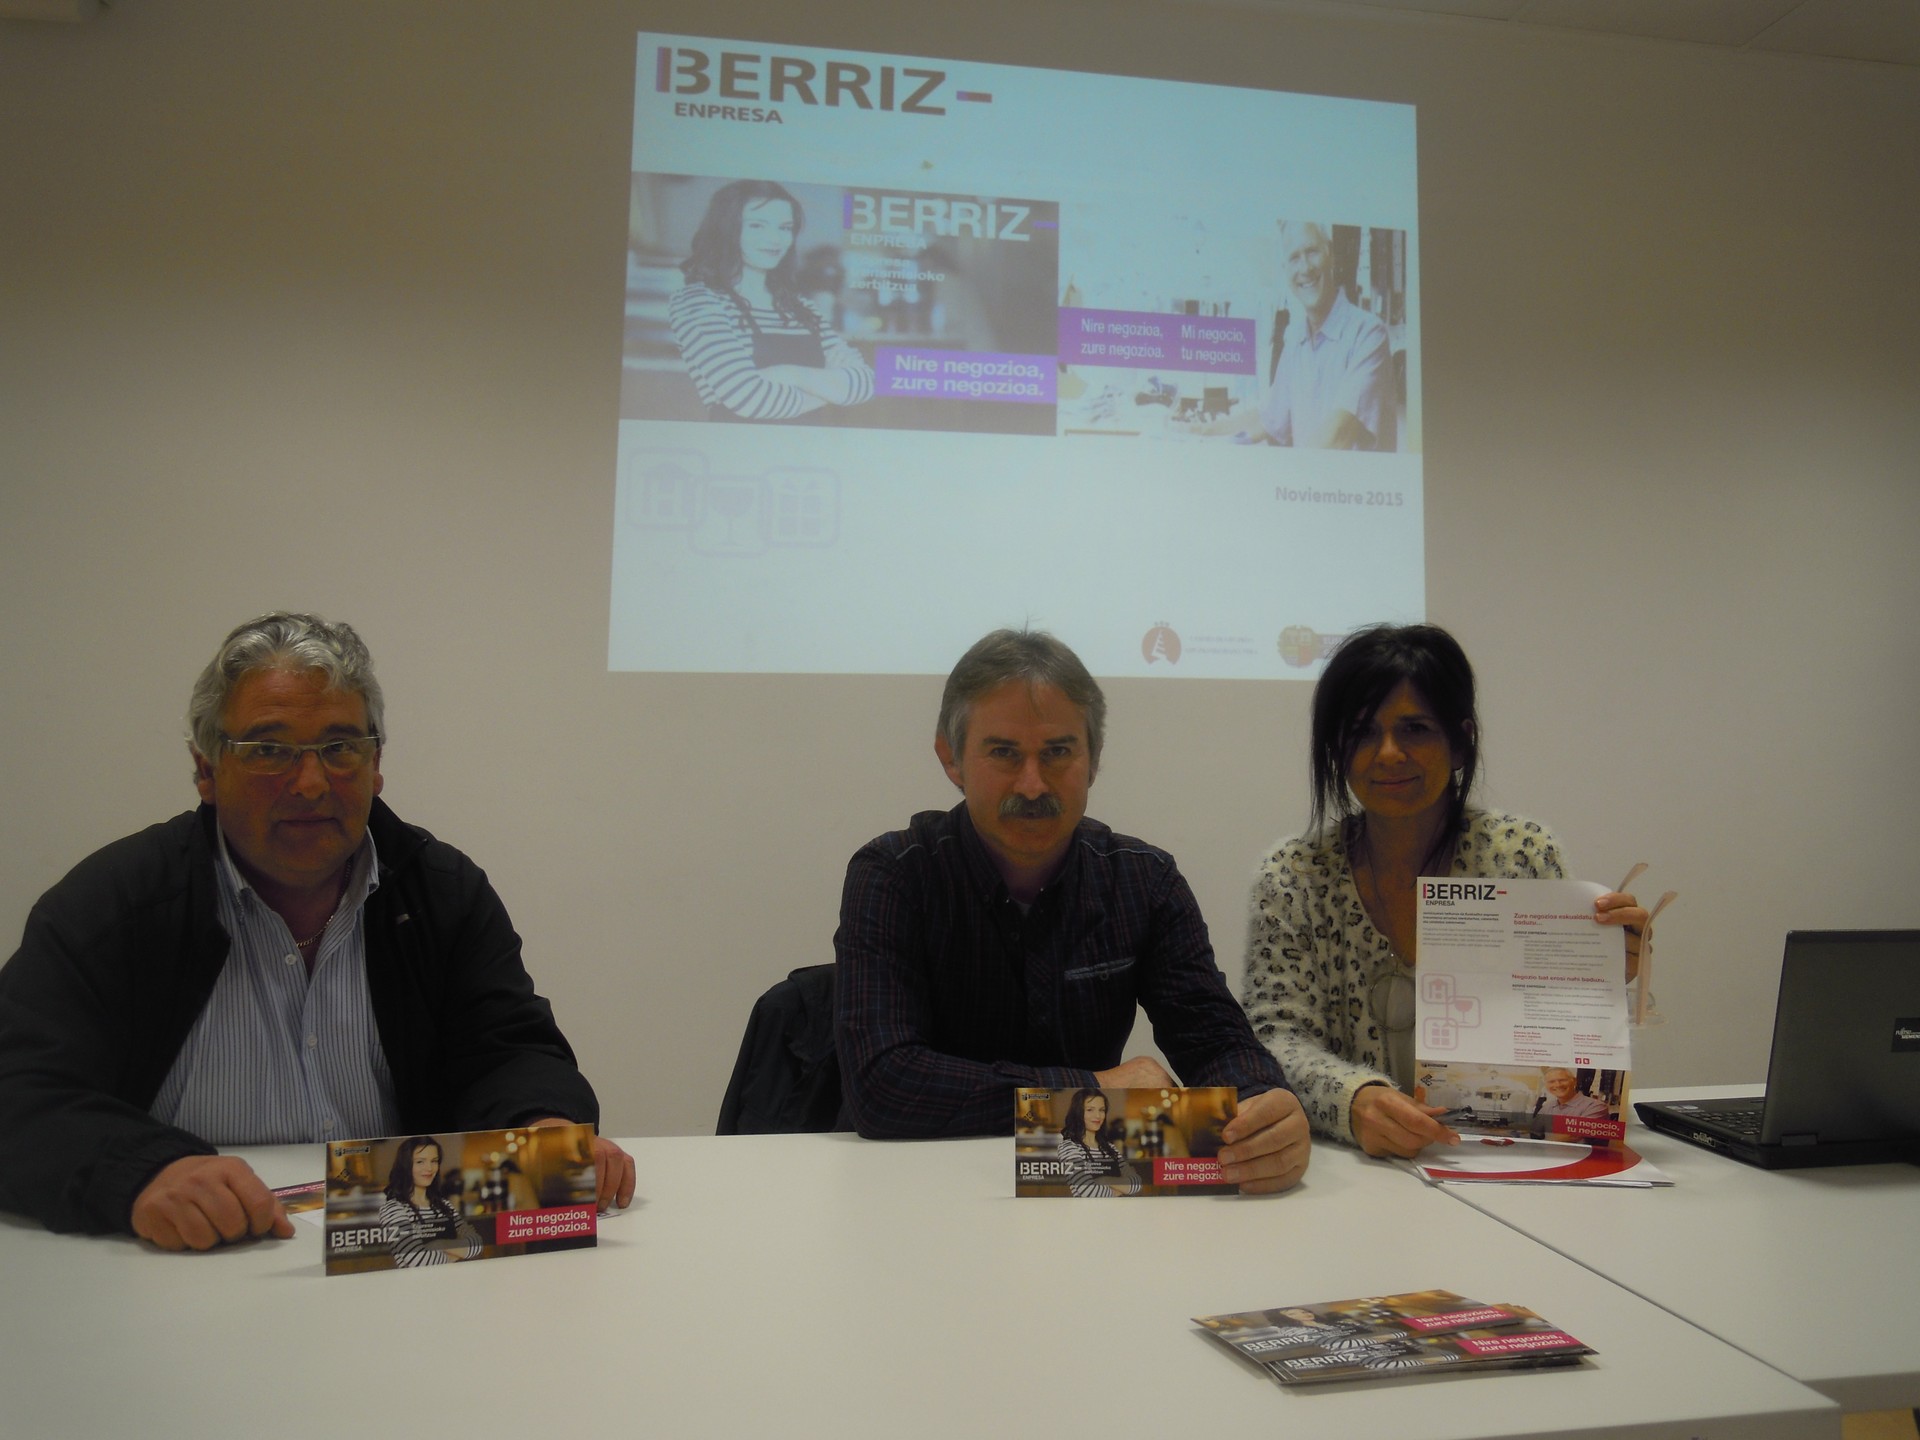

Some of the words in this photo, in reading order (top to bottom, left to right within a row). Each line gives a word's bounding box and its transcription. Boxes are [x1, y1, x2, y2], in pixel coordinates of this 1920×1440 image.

[675, 102, 784, 125] ENPRESA
[1081, 317, 1105, 334] Nire
[1107, 321, 1163, 339] negozioa,
[1181, 324, 1196, 339] Mi
[1198, 327, 1246, 344] negocio,
[1081, 342, 1106, 355] zure
[1109, 344, 1165, 360] negozioa.
[1181, 347, 1193, 361] tu
[1196, 349, 1244, 364] negocio.
[895, 354, 938, 373] Nire
[943, 358, 1045, 380] negozioa,
[891, 375, 937, 391] zure
[943, 377, 1044, 396] negozioa.
[1275, 486, 1363, 505] Noviembre
[1366, 491, 1404, 507] 2015
[1514, 912, 1528, 920] Zure
[1565, 1118, 1577, 1126] Mi
[1579, 1120, 1620, 1131] negocio,
[1578, 1128, 1619, 1137] negocio.
[1164, 1161, 1185, 1170] Nire
[1186, 1162, 1222, 1172] negozi
[1163, 1173, 1185, 1181] zure
[1186, 1171, 1223, 1182] negozi
[509, 1214, 533, 1226] Nire
[536, 1210, 590, 1224] negozioa,
[508, 1228, 533, 1238] zure
[536, 1221, 591, 1236] negozioa.
[1471, 1339, 1500, 1347] Nire
[1479, 1343, 1508, 1351] zure
